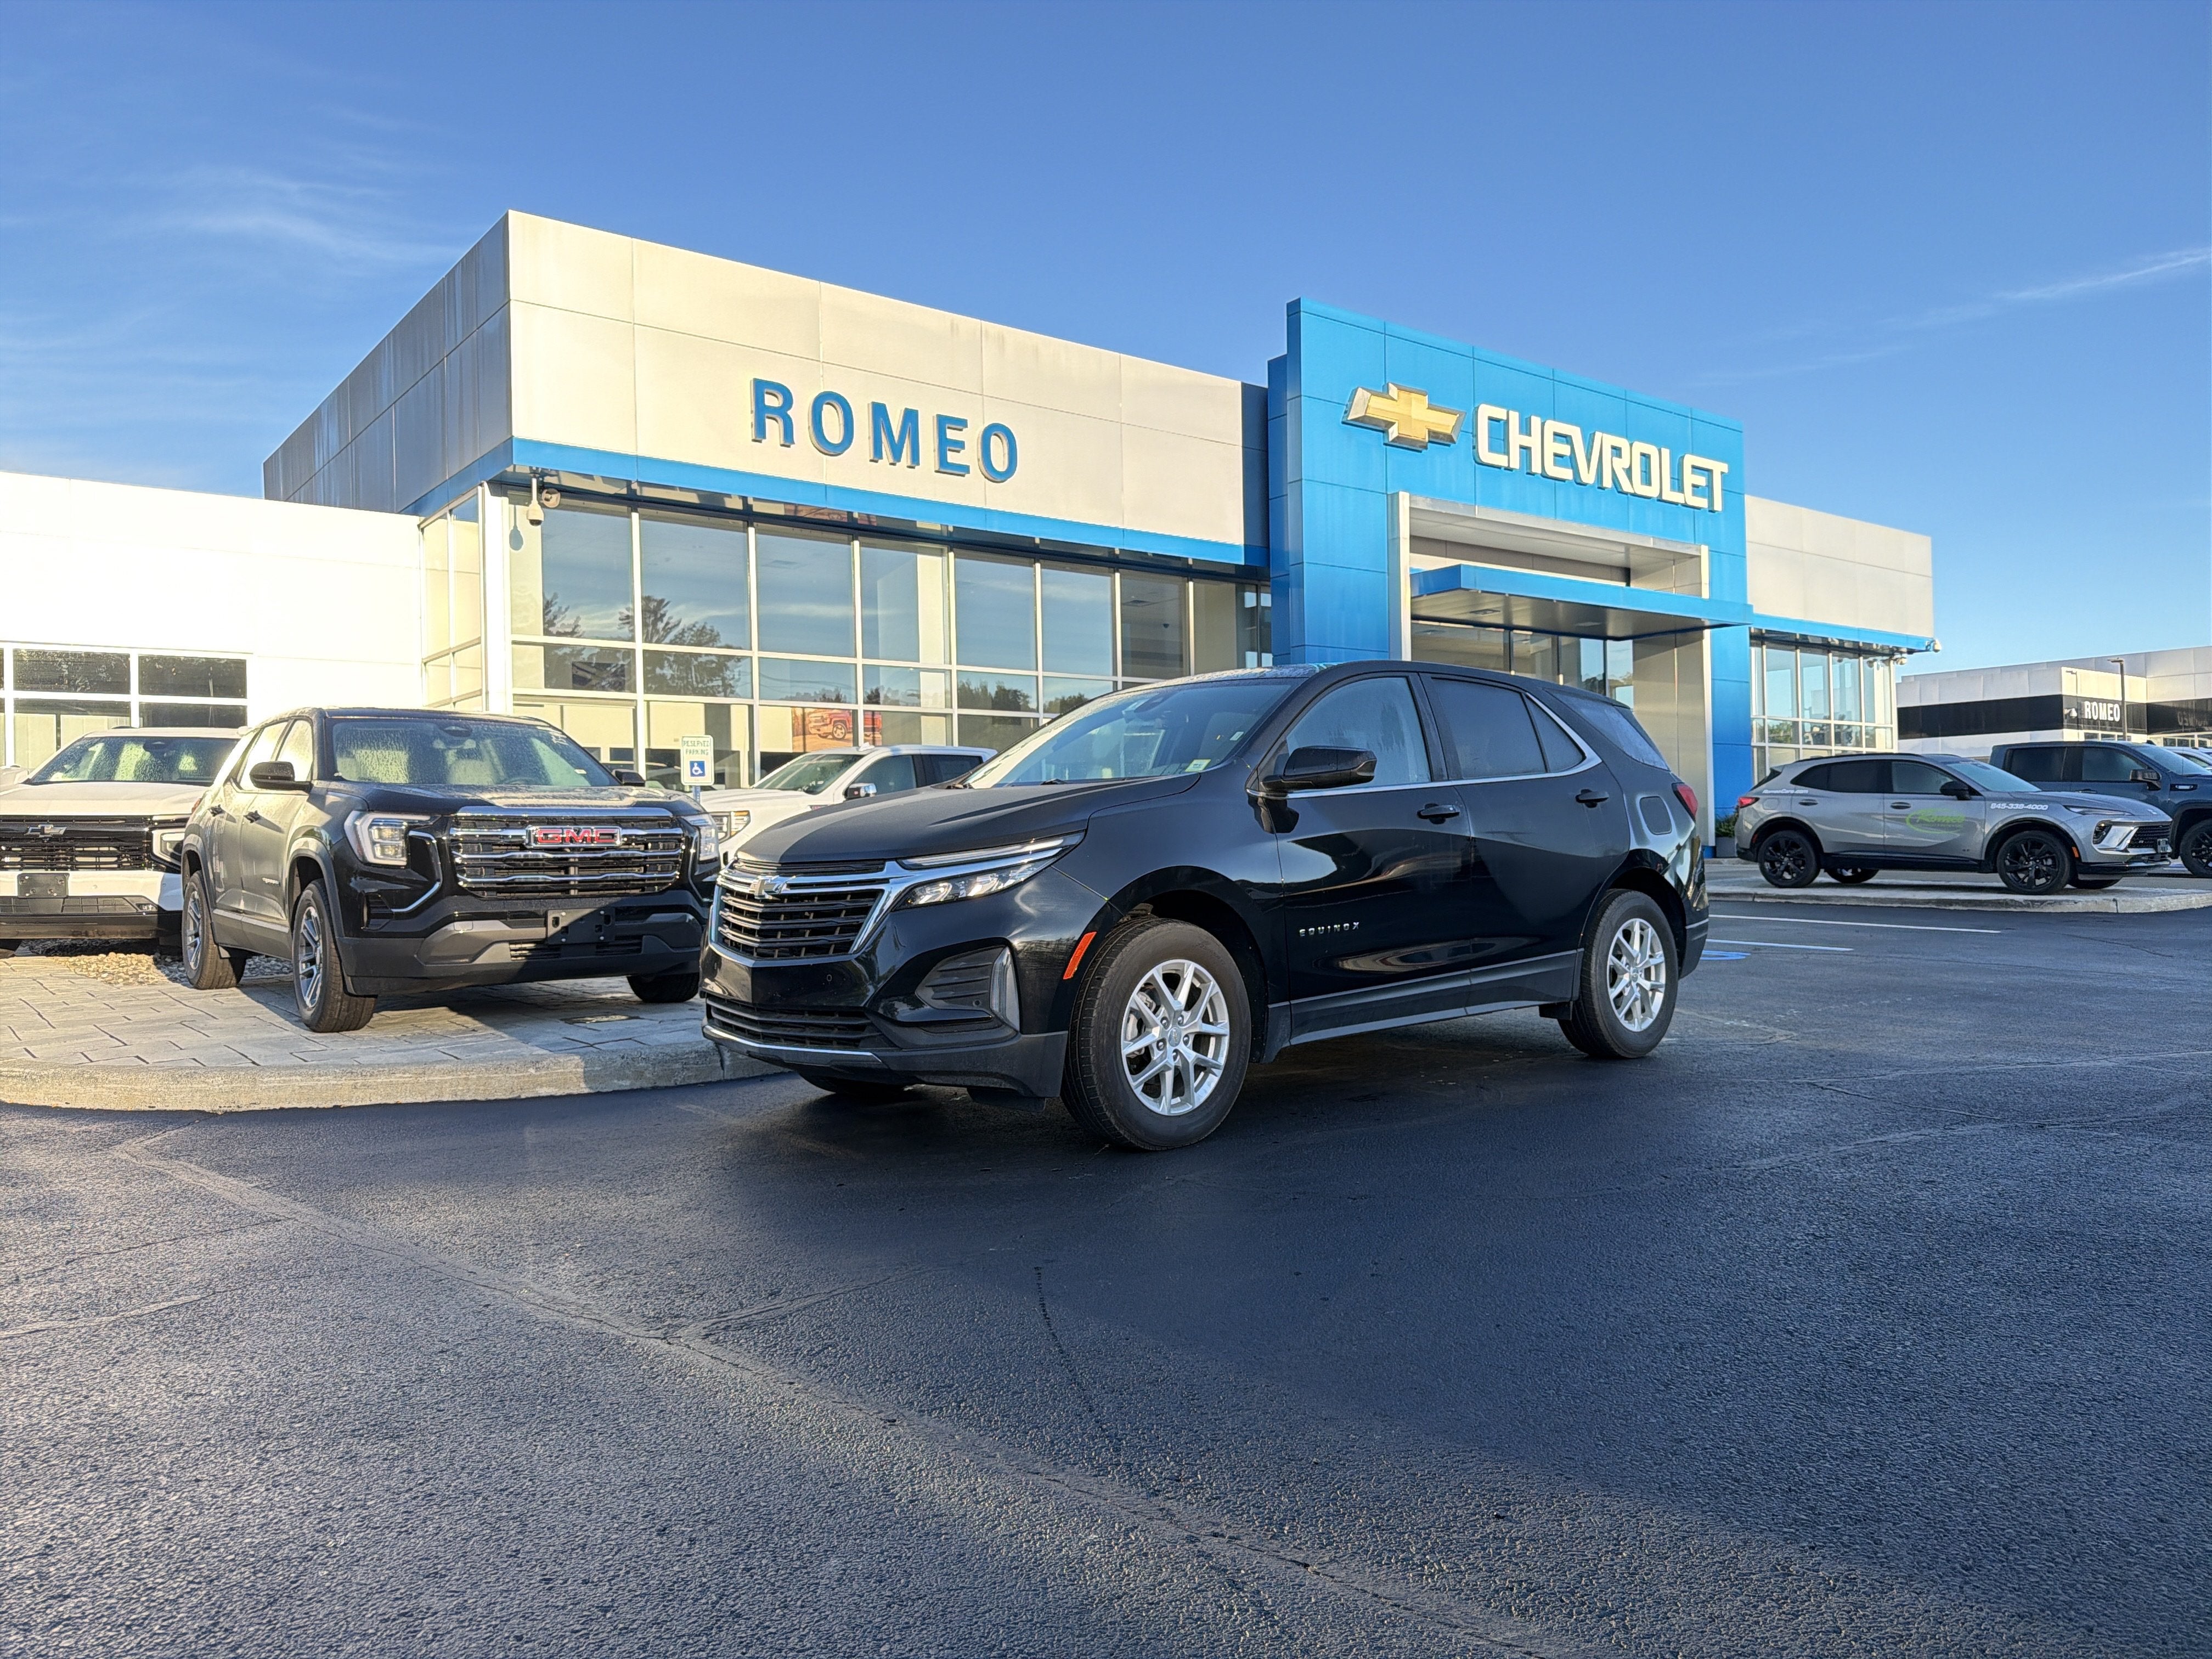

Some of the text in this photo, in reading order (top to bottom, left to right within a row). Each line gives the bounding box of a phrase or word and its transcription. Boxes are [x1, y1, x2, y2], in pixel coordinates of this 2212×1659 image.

[751, 377, 1018, 483] ROMEO
[1475, 403, 1728, 512] CHEVROLET
[2084, 701, 2120, 722] ROMEO
[537, 828, 617, 844] GMC
[1299, 922, 1359, 936] EQUINOX
